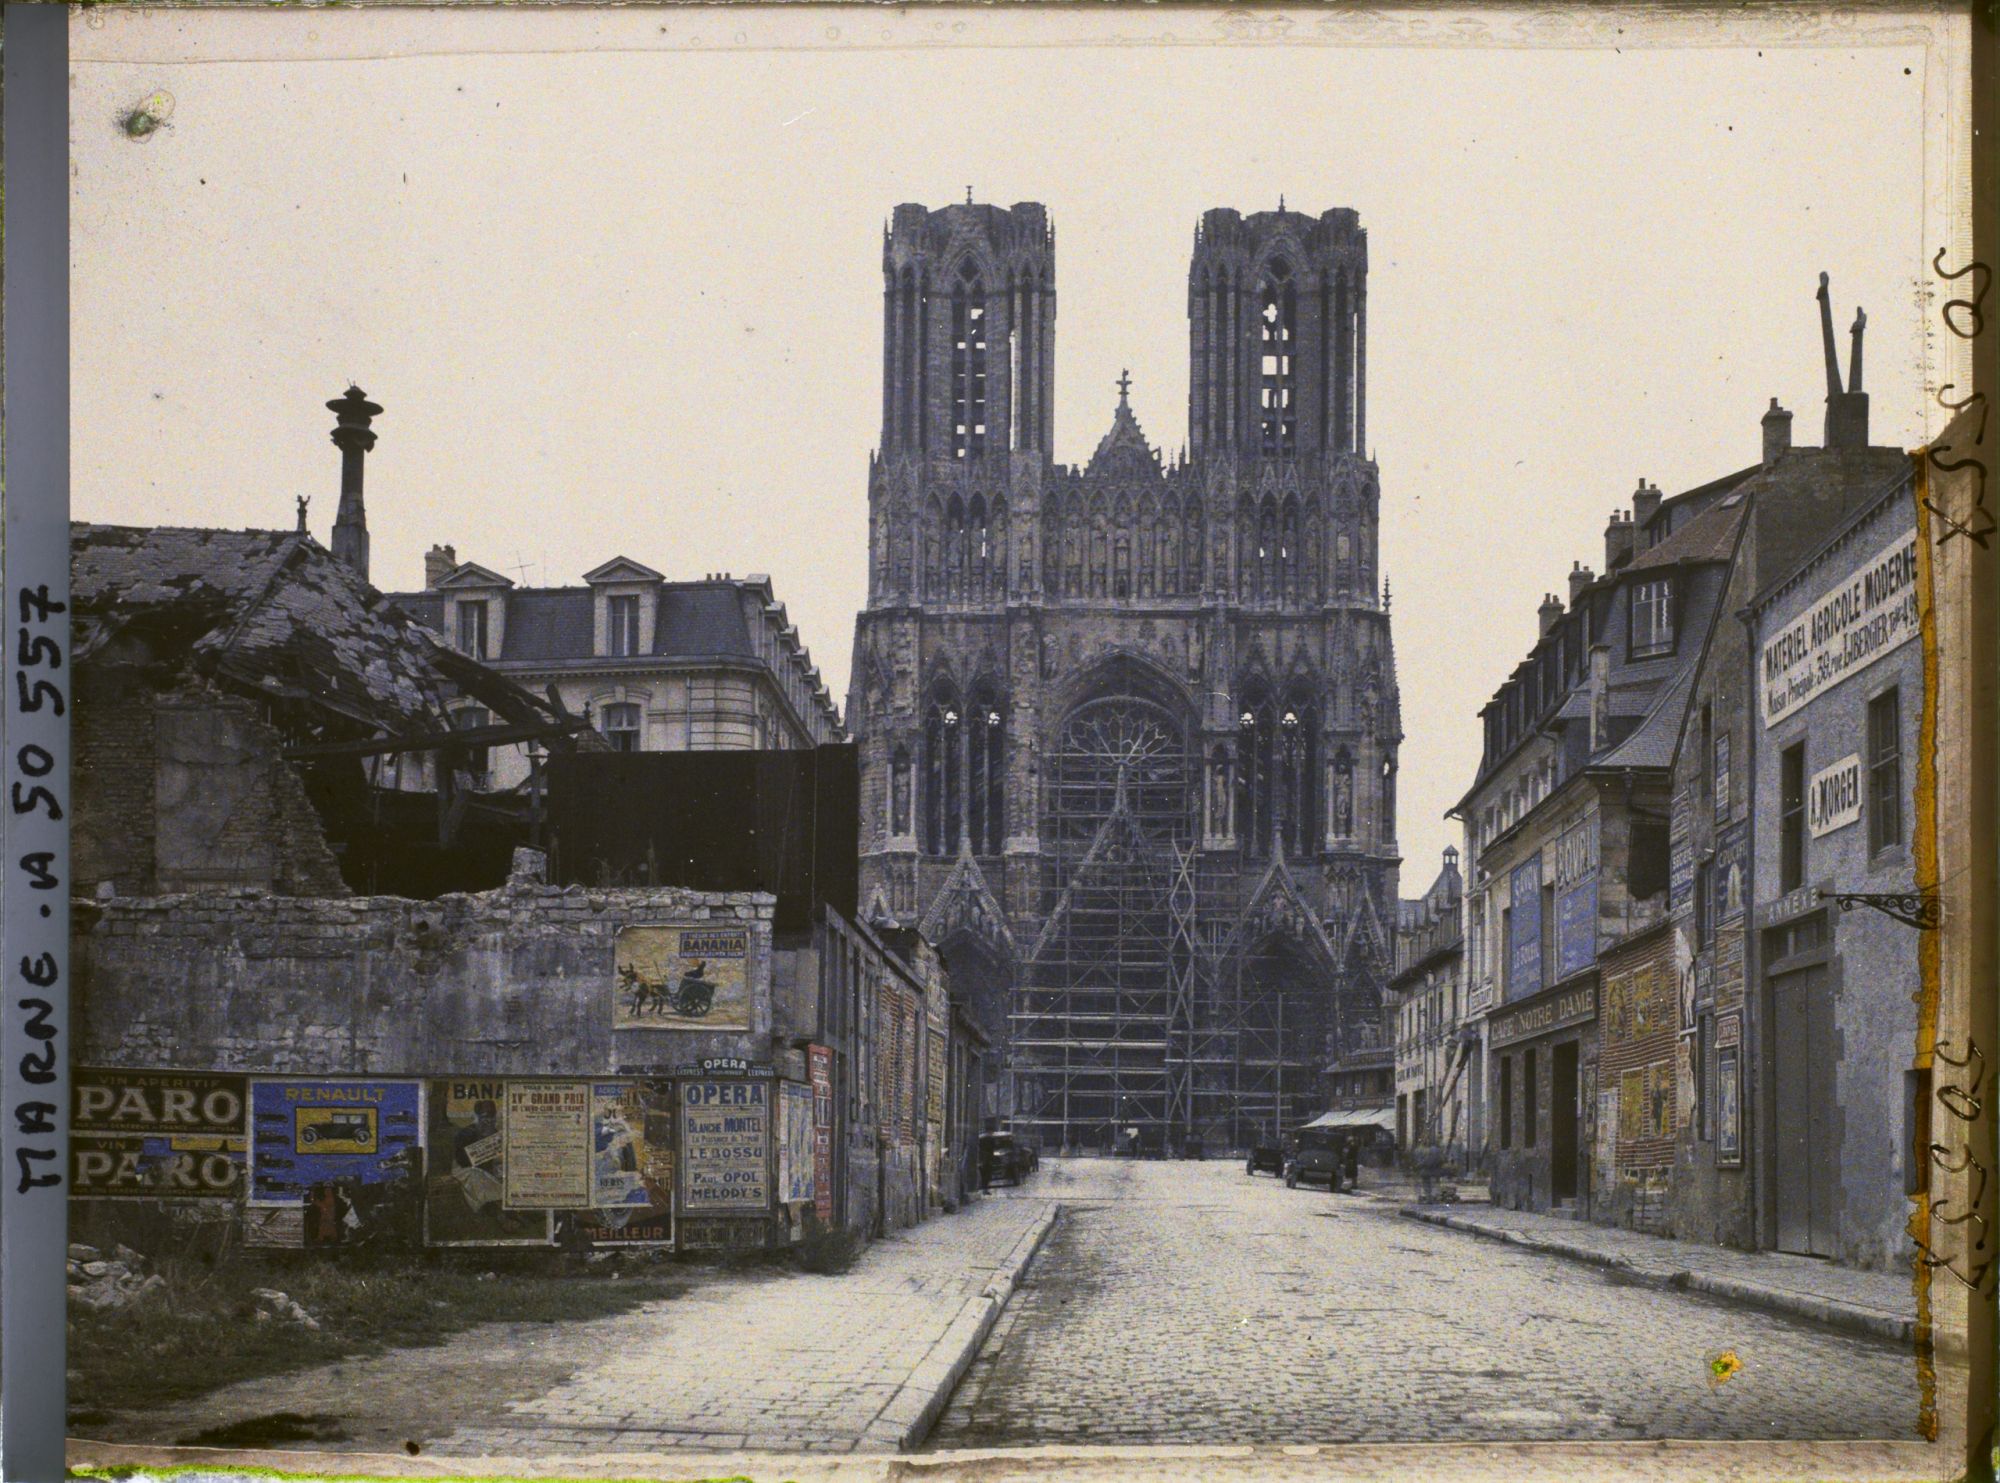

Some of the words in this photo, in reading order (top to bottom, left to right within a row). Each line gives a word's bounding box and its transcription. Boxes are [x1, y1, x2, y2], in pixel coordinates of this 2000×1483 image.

[1811, 581, 1861, 652] AGRICOLE
[1864, 541, 1918, 612] MODERNE
[18, 583, 67, 715] 557
[1844, 613, 1888, 668] LIBERGIER
[13, 743, 63, 821] 50
[1768, 887, 1817, 923] ANNEXE
[683, 939, 744, 950] BANANIA
[1519, 1004, 1553, 1033] NOTRE
[1559, 988, 1594, 1020] DAME
[704, 1058, 747, 1070] OPERA
[15, 952, 58, 1194] MARNE
[98, 1076, 127, 1085] VIN
[137, 1078, 220, 1089] APERITIF
[285, 1088, 387, 1102] RENAULT
[531, 1093, 560, 1104] GRAND
[564, 1093, 584, 1104] PRIX
[686, 1085, 764, 1104] OPERA
[76, 1085, 241, 1125] PARO
[724, 1117, 762, 1133] MONTEL
[97, 1141, 126, 1150] VIN
[690, 1148, 707, 1159] LE
[711, 1147, 762, 1158] BOSSU
[76, 1151, 239, 1189] PARO
[723, 1172, 759, 1183] OPOL
[691, 1188, 762, 1200] MELODY'S
